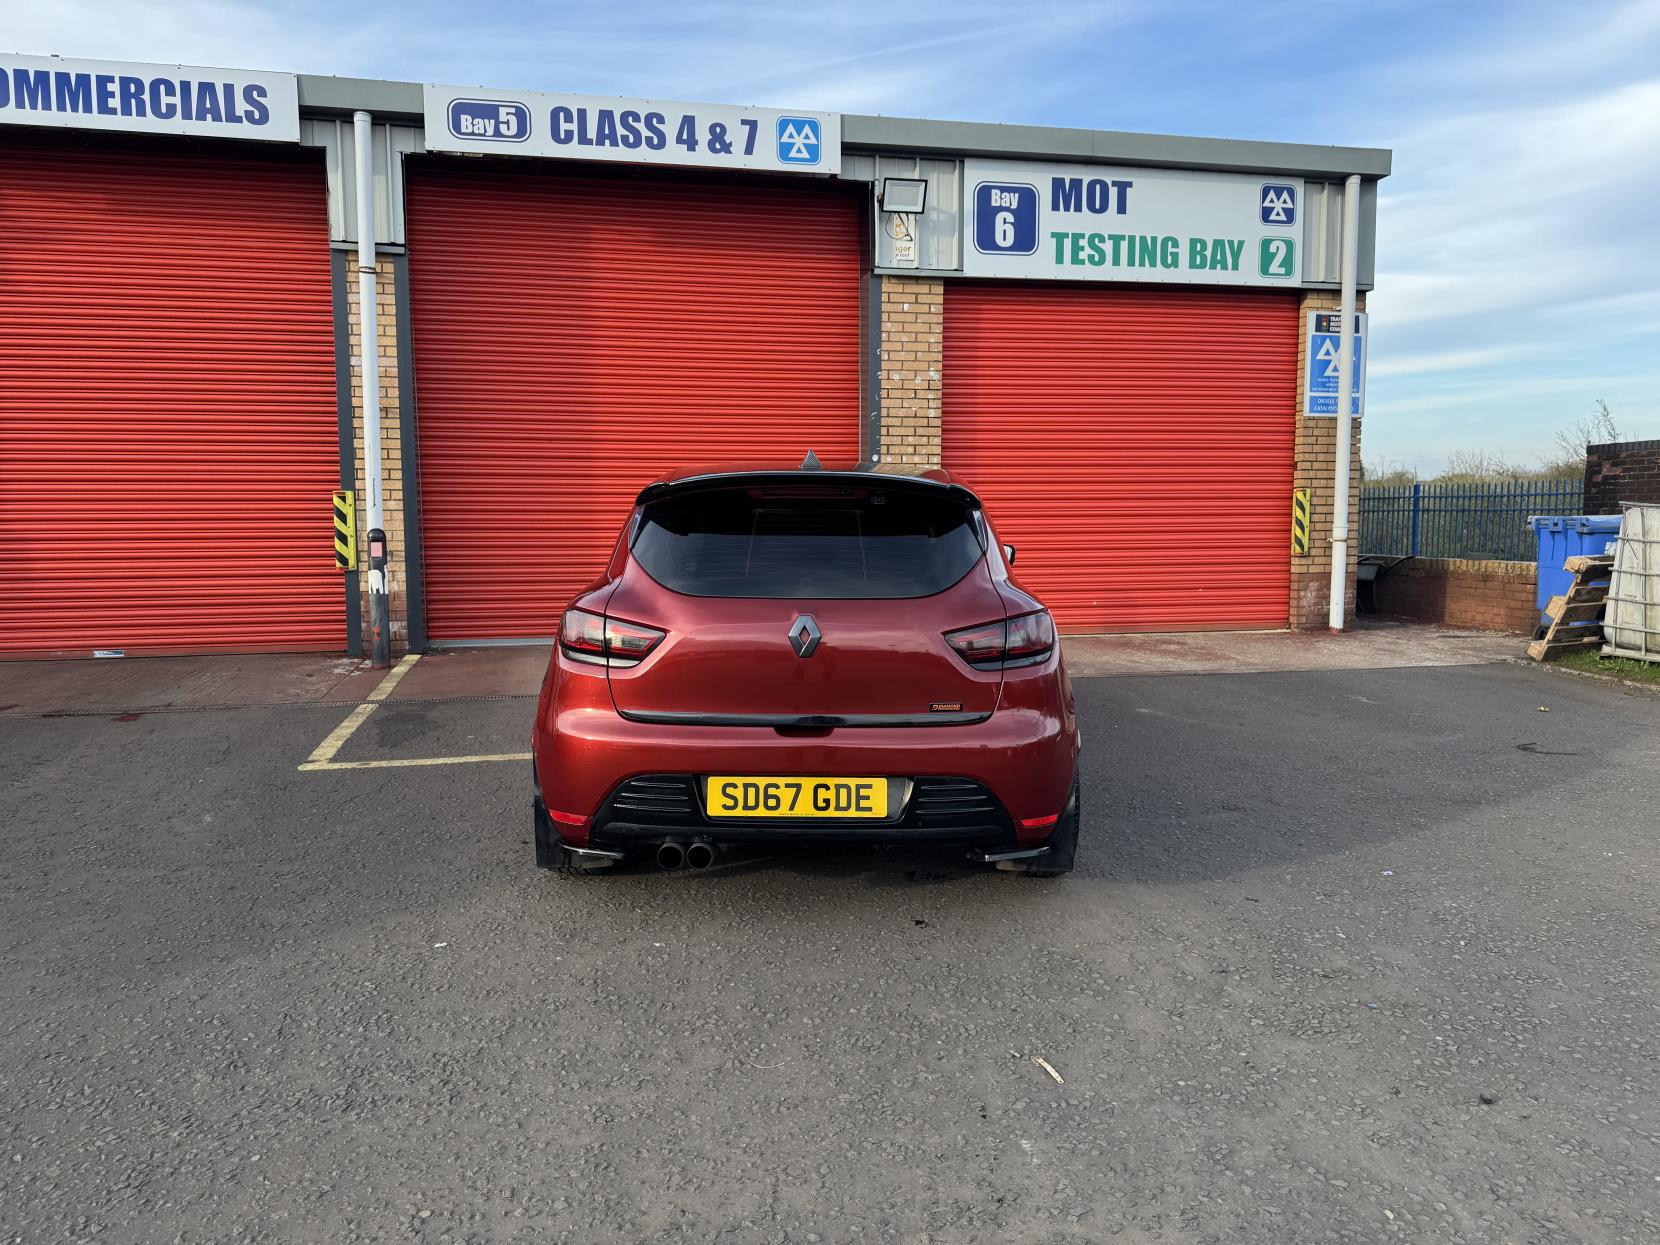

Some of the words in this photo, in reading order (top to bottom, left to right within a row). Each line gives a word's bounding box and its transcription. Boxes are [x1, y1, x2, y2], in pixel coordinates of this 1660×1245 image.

[461, 114, 495, 136] Bay
[498, 106, 518, 136] 5
[550, 106, 667, 151] CLASS
[676, 114, 699, 153] 4
[707, 122, 733, 155] &
[741, 118, 759, 156] 7
[991, 189, 1019, 209] Bay
[1050, 176, 1134, 216] MOT
[995, 211, 1015, 248] 6
[1050, 231, 1180, 270] TESTING
[1188, 237, 1245, 272] BAY
[1269, 240, 1288, 274] 2
[721, 782, 803, 812] SD67
[812, 783, 873, 812] GDE
